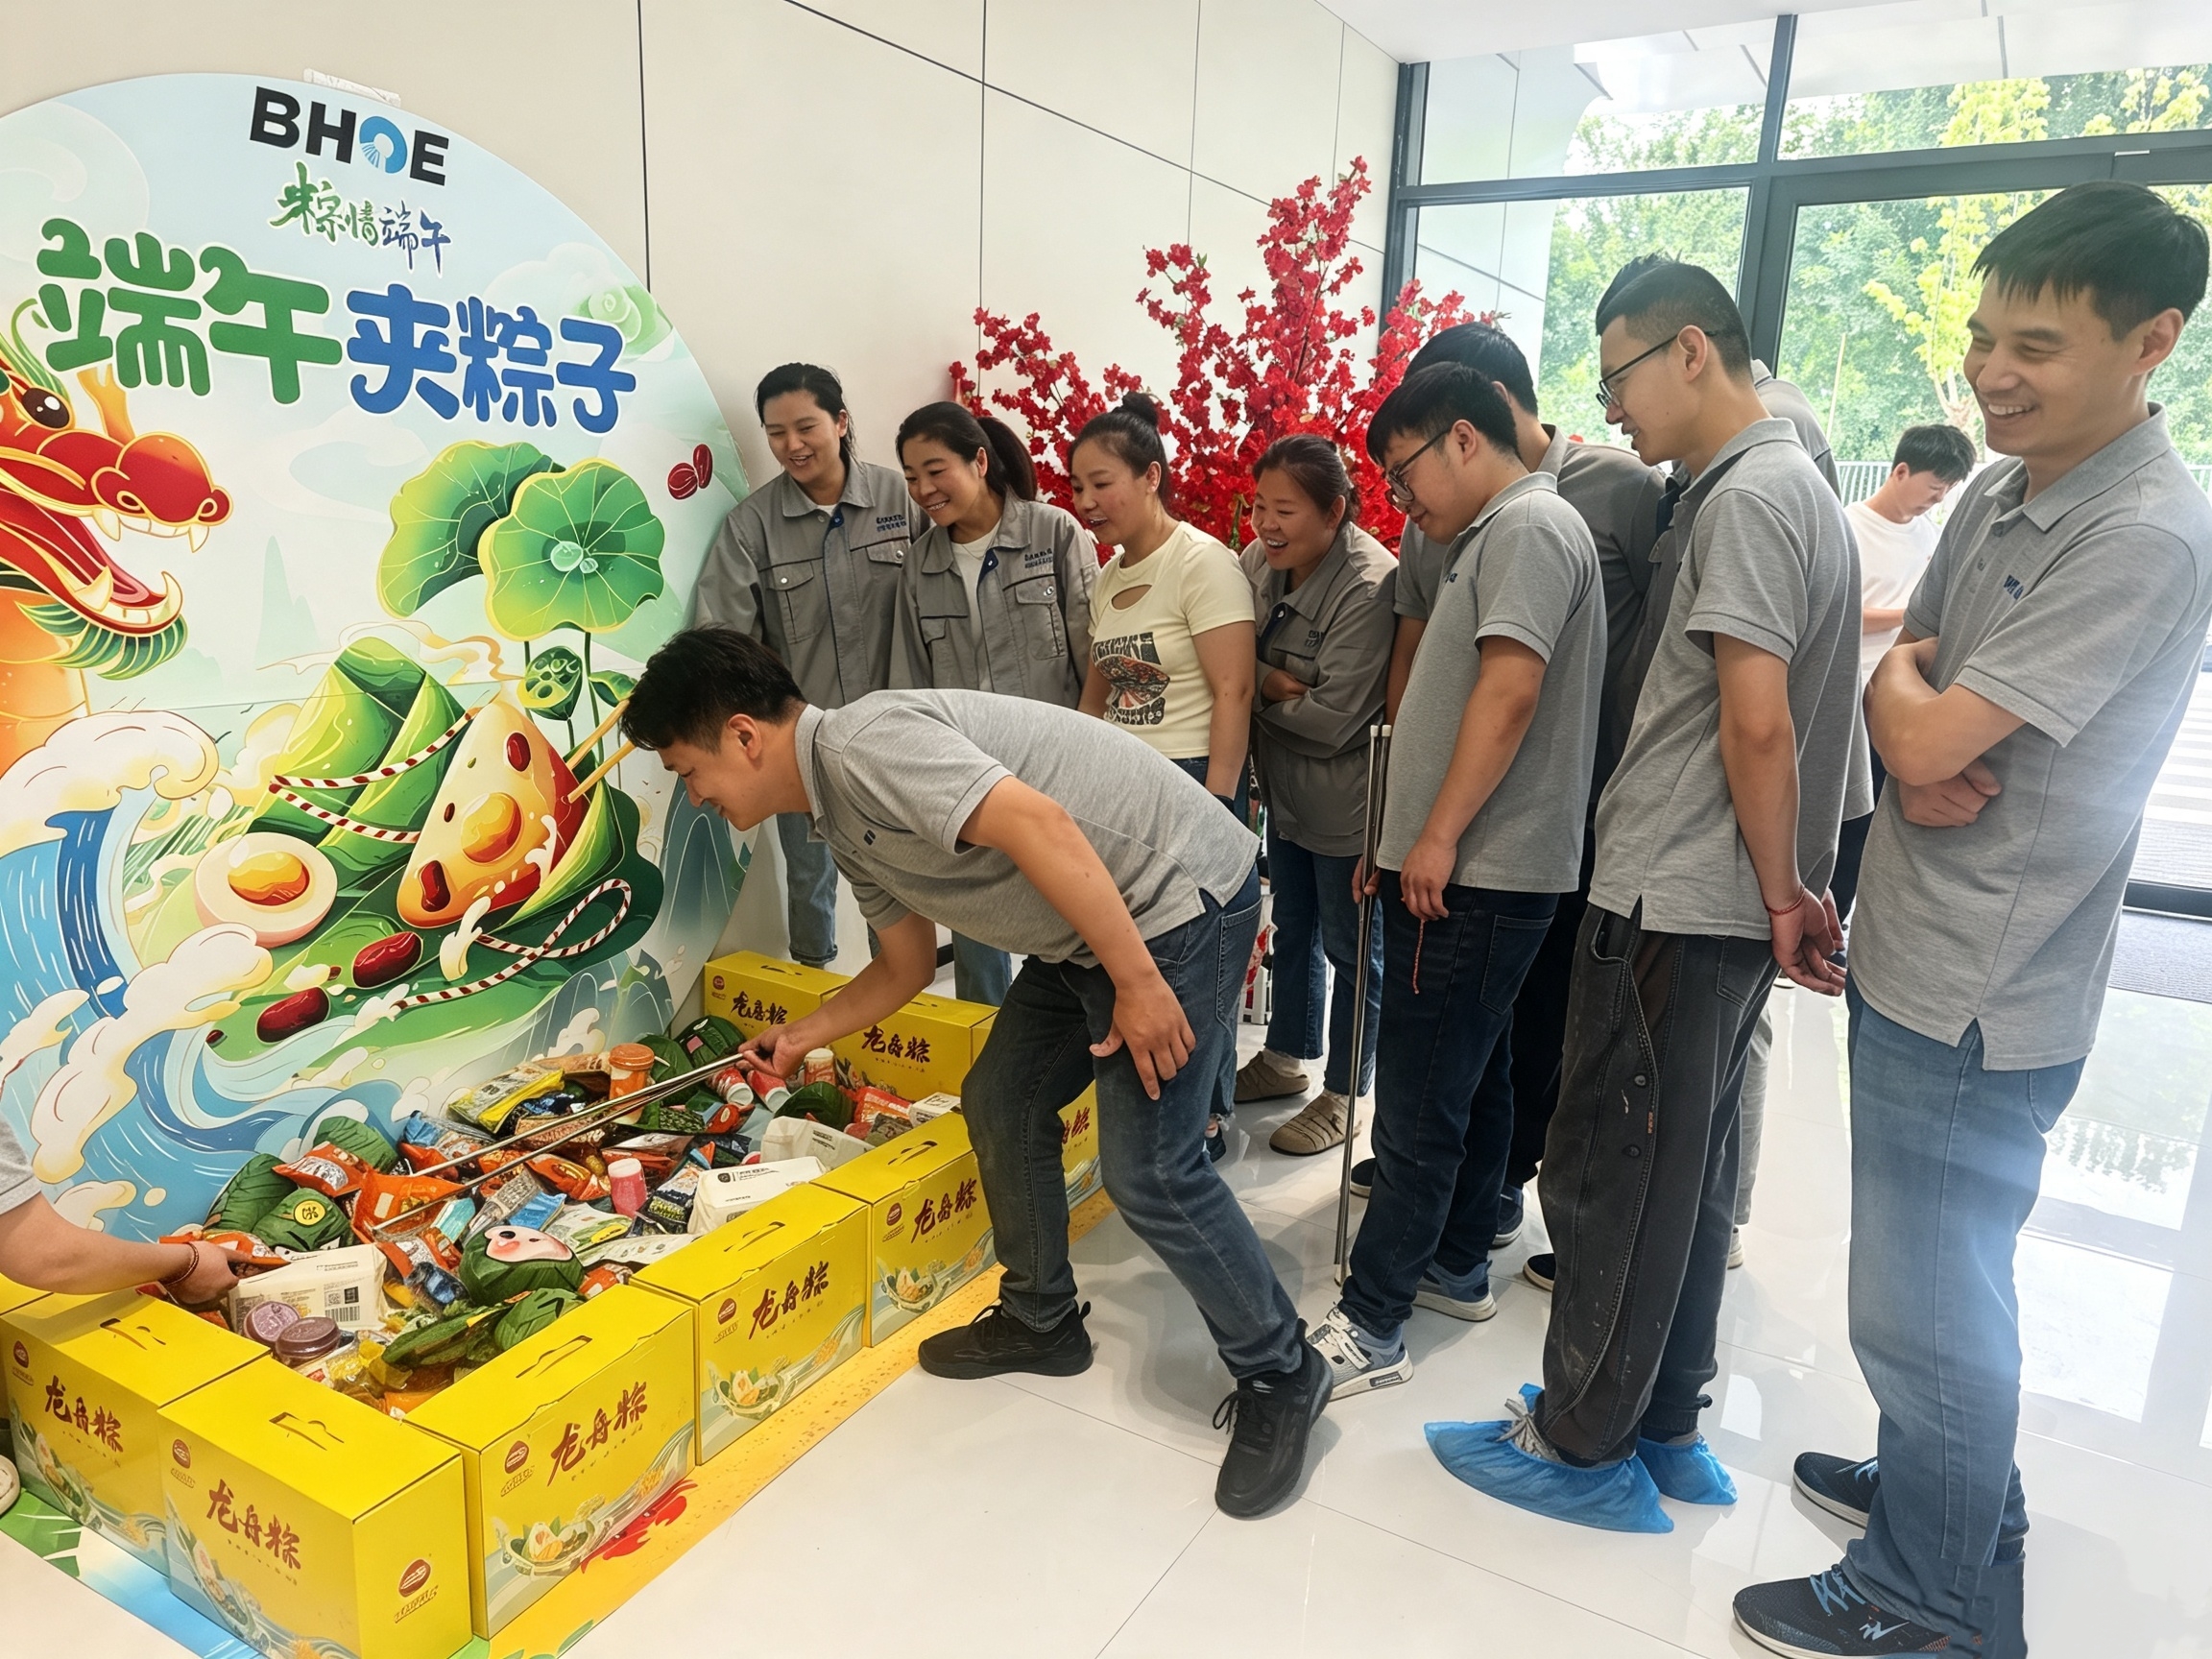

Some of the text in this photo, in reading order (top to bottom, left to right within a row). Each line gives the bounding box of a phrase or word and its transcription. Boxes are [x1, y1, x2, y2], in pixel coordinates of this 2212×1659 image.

[270, 161, 451, 274] 粽情端午
[36, 218, 637, 434] 端午夹粽子
[546, 1382, 648, 1487] 龙舟粽
[206, 1479, 301, 1570] 龙舟粽
